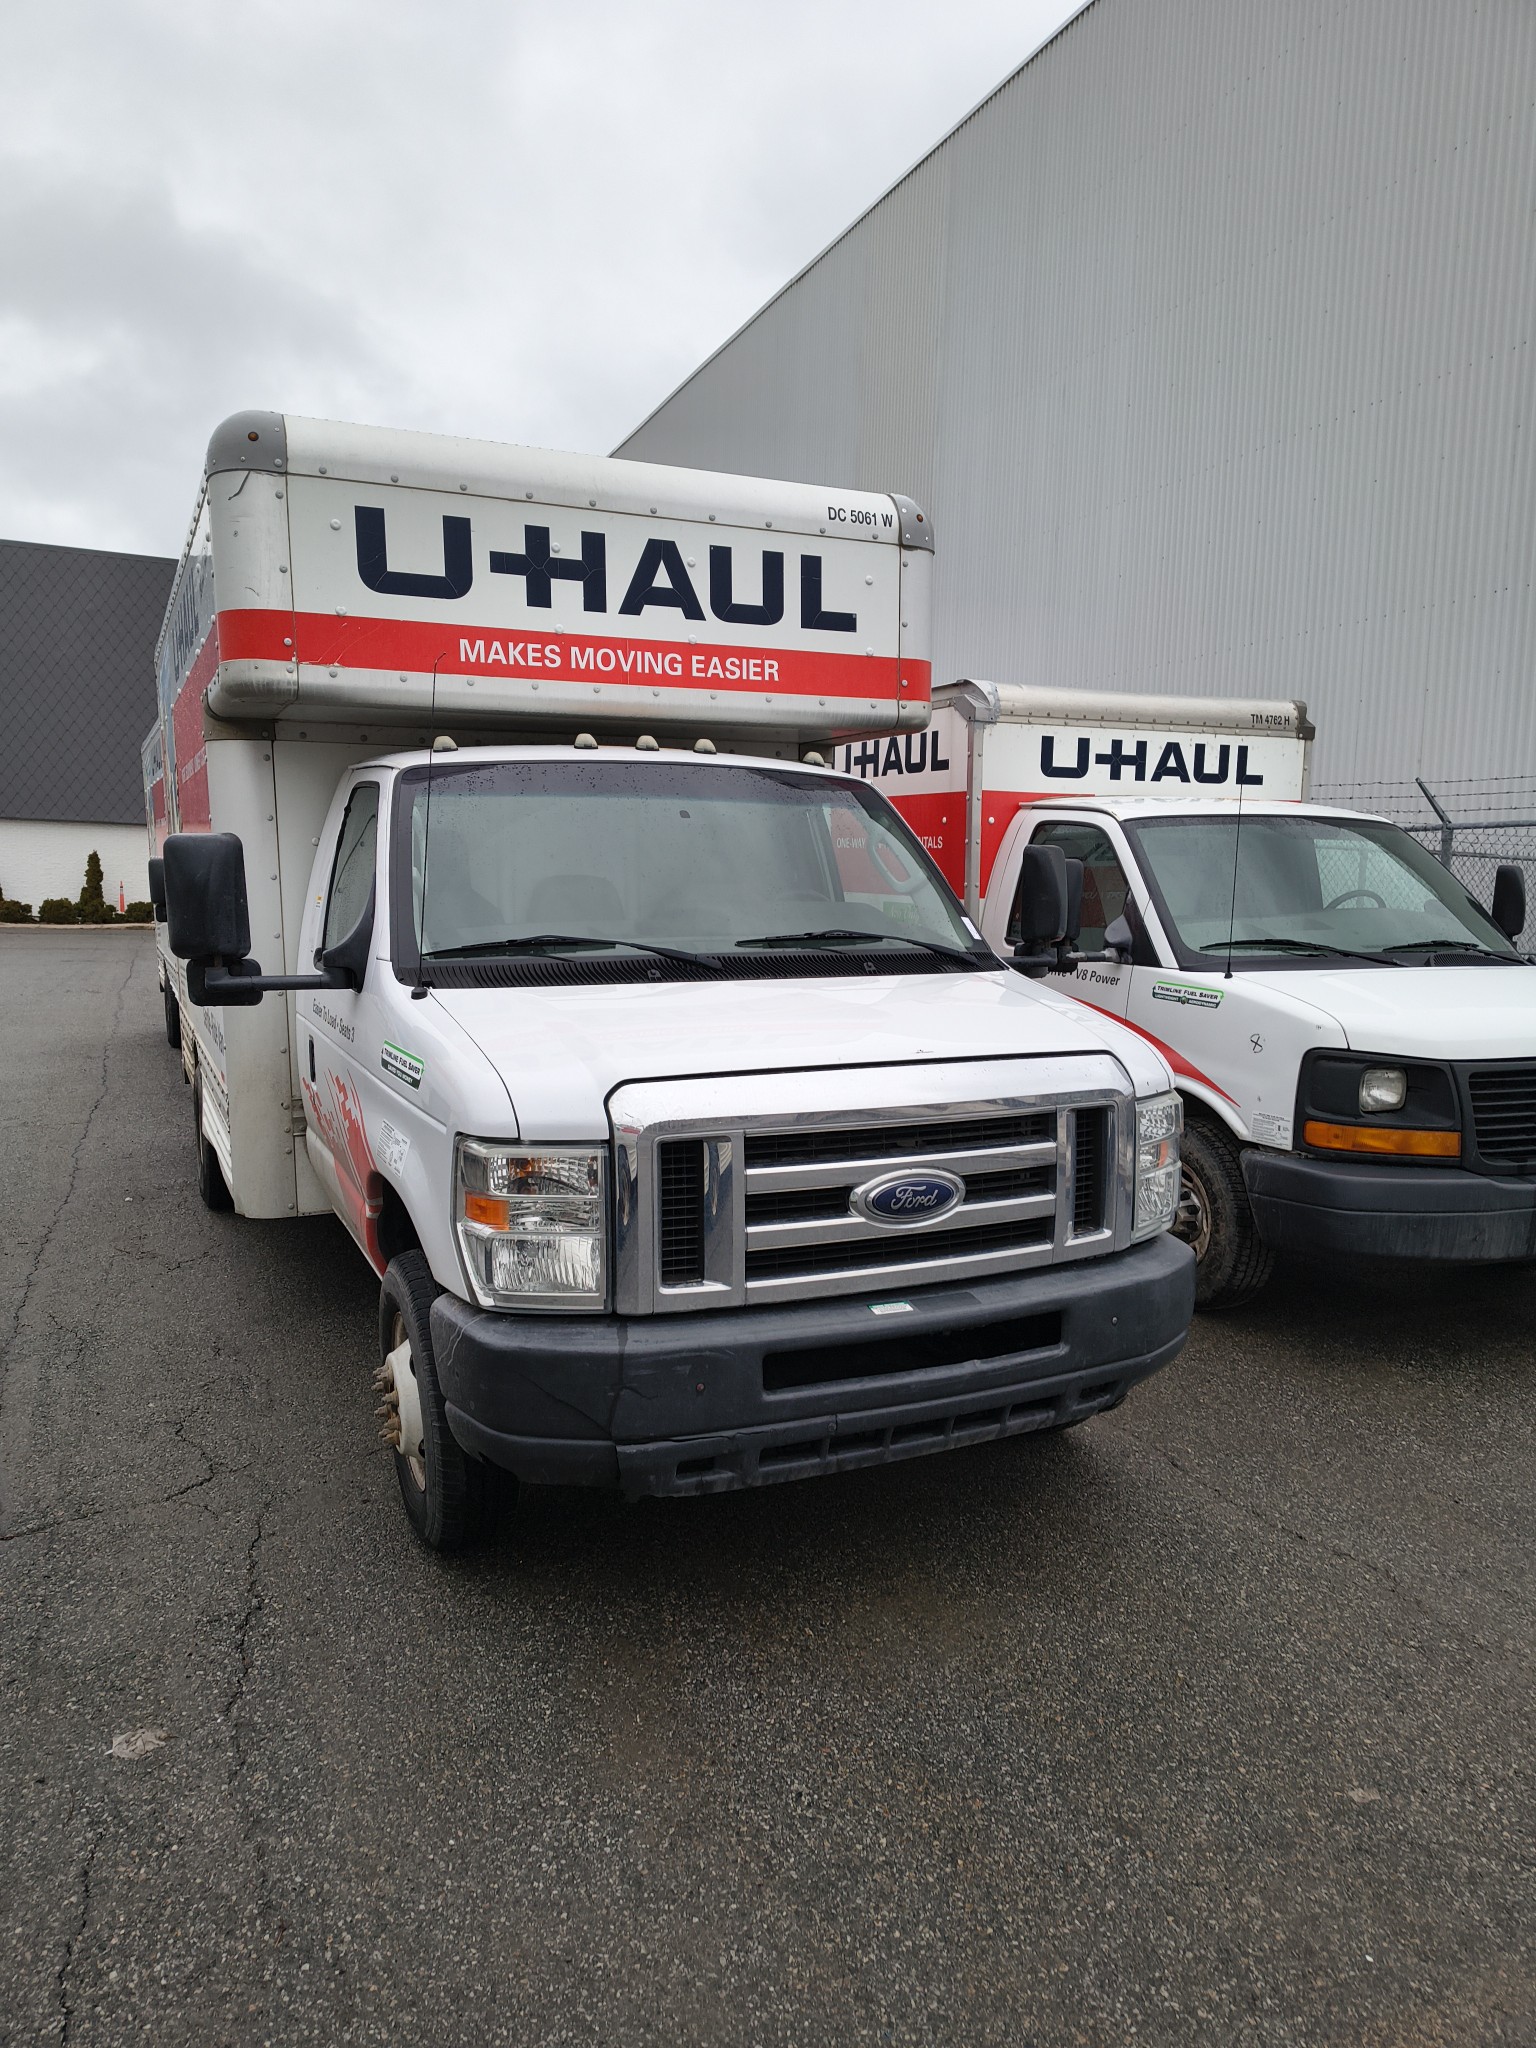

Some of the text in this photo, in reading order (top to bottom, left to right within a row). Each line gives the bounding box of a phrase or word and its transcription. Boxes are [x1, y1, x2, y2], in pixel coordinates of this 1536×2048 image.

[827, 505, 894, 528] DC 5061 W
[459, 638, 780, 681] MAKES MOVING EASIER
[1251, 713, 1290, 726] TM 4762 H
[836, 837, 866, 849] ONE-WAY
[1076, 968, 1089, 981] V8
[1089, 970, 1121, 986] Power
[1183, 989, 1198, 997] FUEL
[1198, 992, 1219, 1000] SAVER
[338, 1017, 351, 1041] Seats
[351, 1026, 355, 1043] 3
[890, 1185, 939, 1210] Ford
